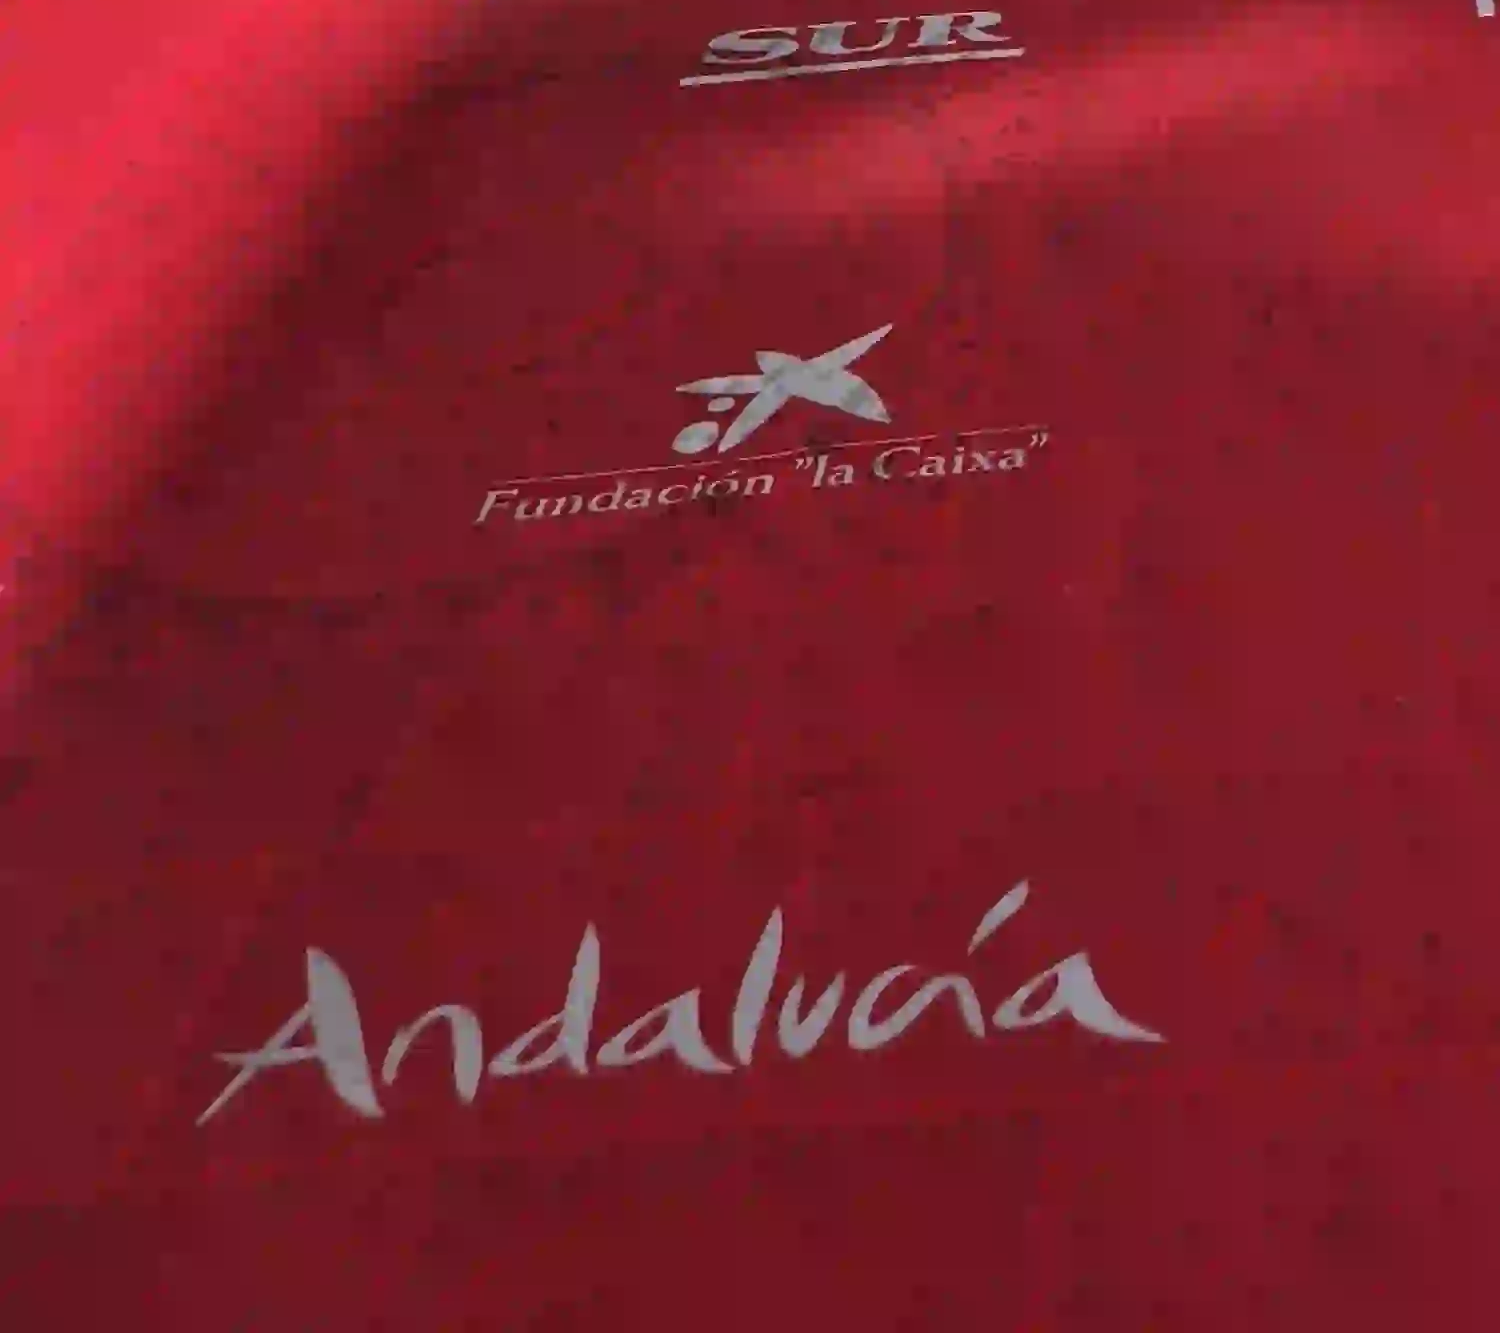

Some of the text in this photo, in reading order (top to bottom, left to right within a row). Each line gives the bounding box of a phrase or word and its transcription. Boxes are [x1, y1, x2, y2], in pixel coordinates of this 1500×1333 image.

[702, 10, 1012, 65] SUR
[473, 469, 776, 526] Fundación
[196, 878, 1169, 1127] Andalucía
